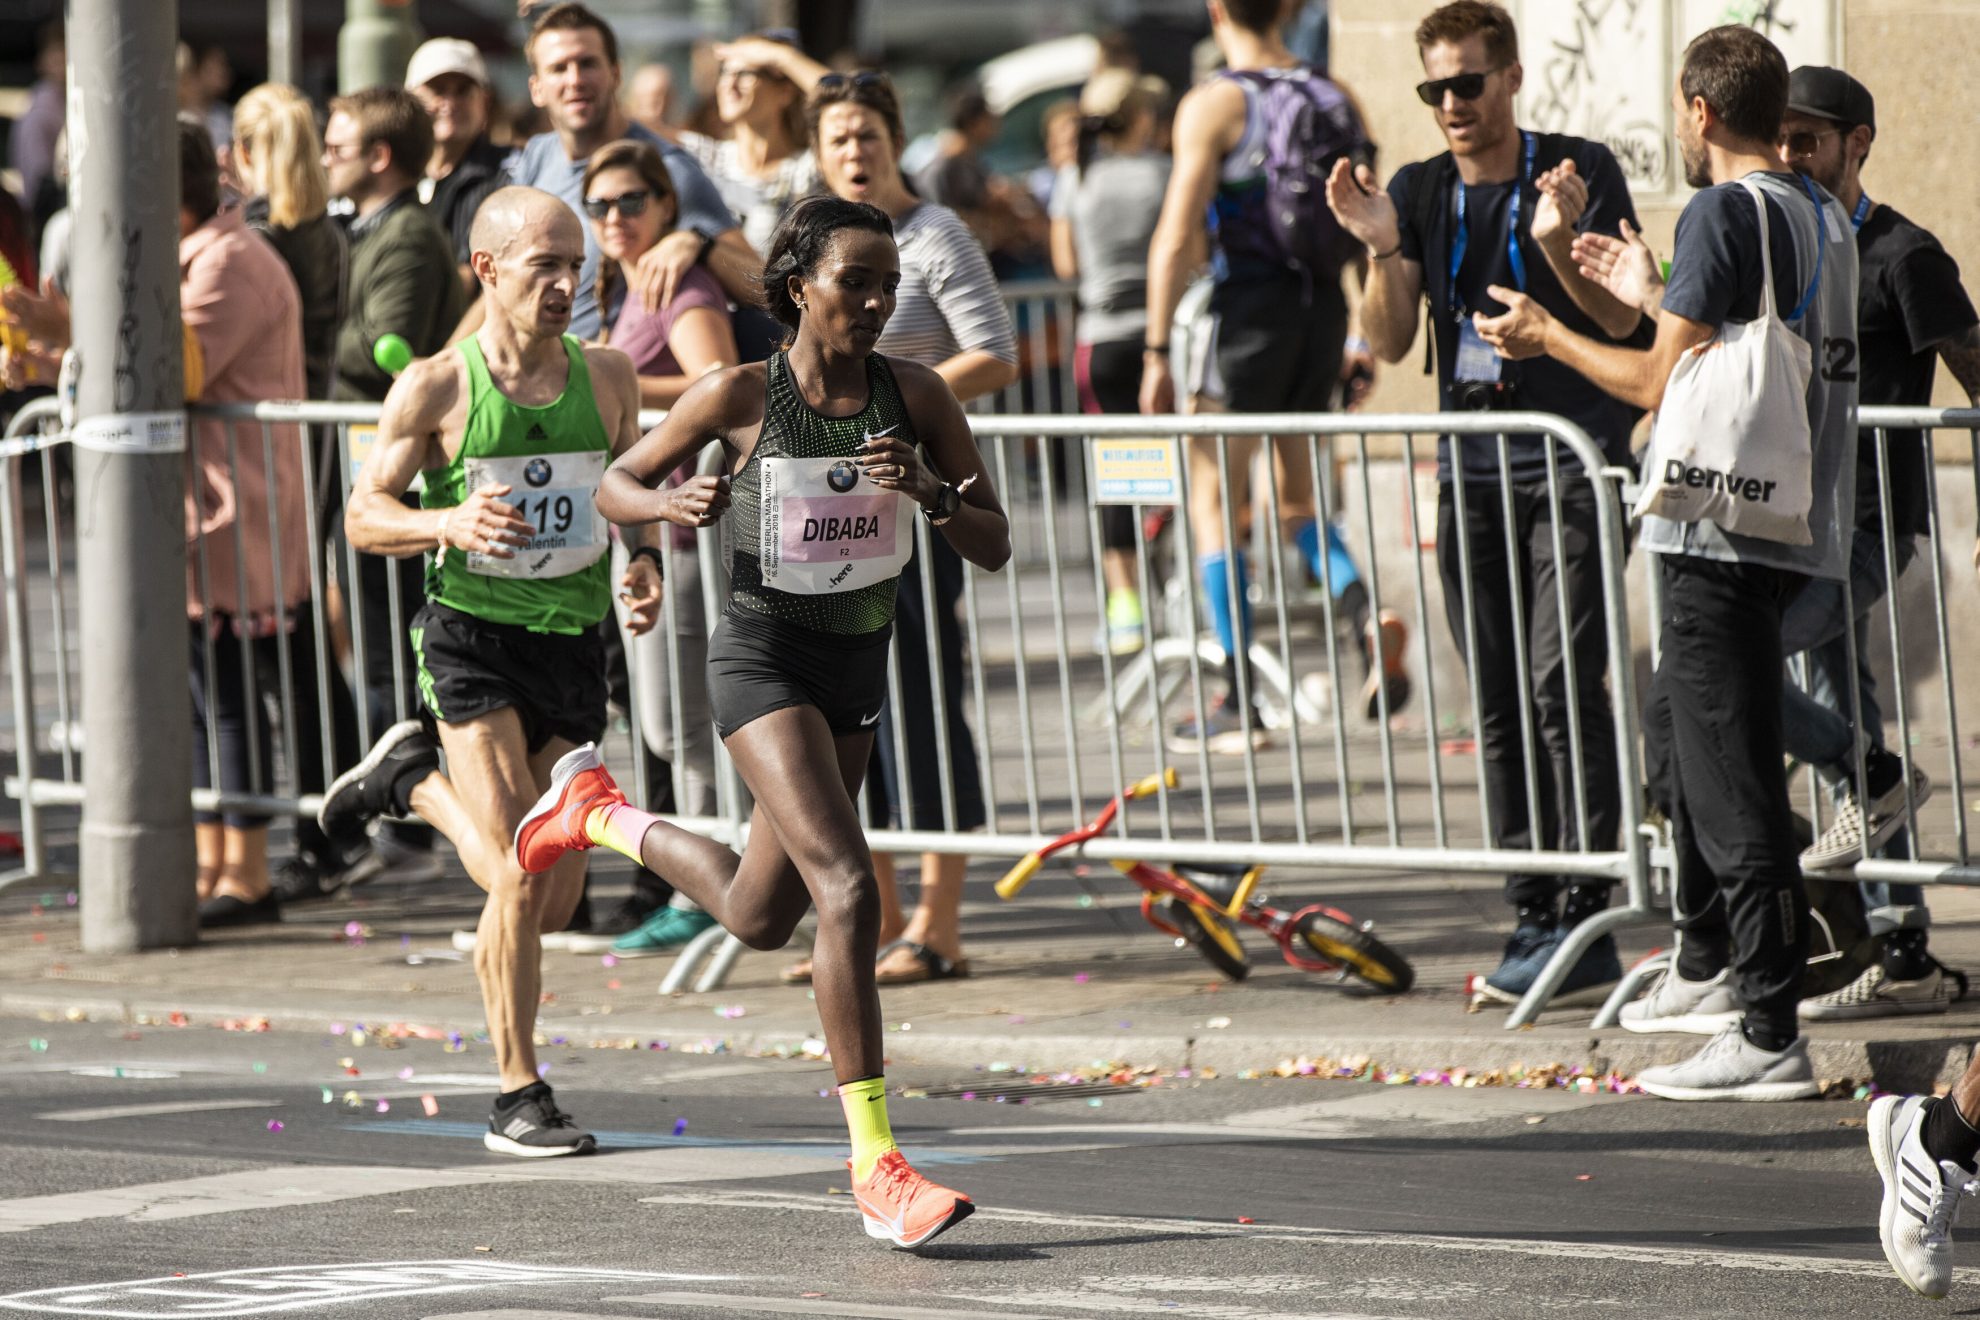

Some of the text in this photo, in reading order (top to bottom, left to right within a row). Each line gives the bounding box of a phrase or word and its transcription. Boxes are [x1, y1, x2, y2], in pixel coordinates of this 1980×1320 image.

[1664, 459, 1776, 503] Denver
[802, 515, 879, 542] DIBABA
[840, 548, 850, 556] F2
[829, 563, 854, 586] here
